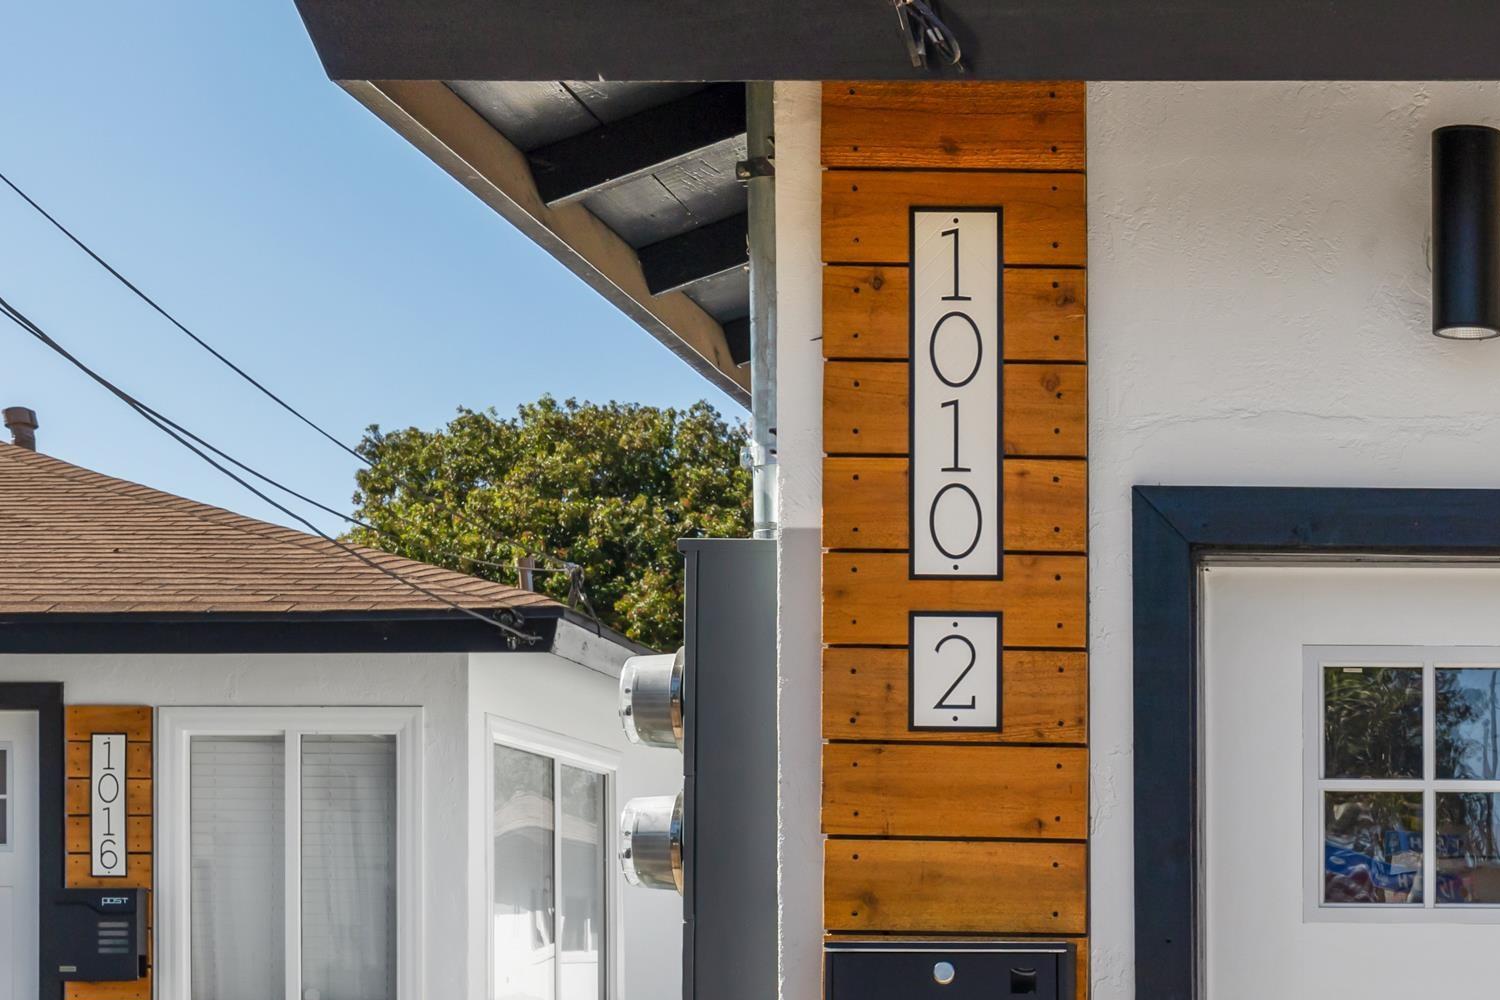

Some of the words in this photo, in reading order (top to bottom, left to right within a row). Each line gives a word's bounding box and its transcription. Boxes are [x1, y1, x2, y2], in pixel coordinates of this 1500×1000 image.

[929, 228, 983, 560] 1010
[932, 634, 976, 710] 2
[98, 741, 119, 870] 1016
